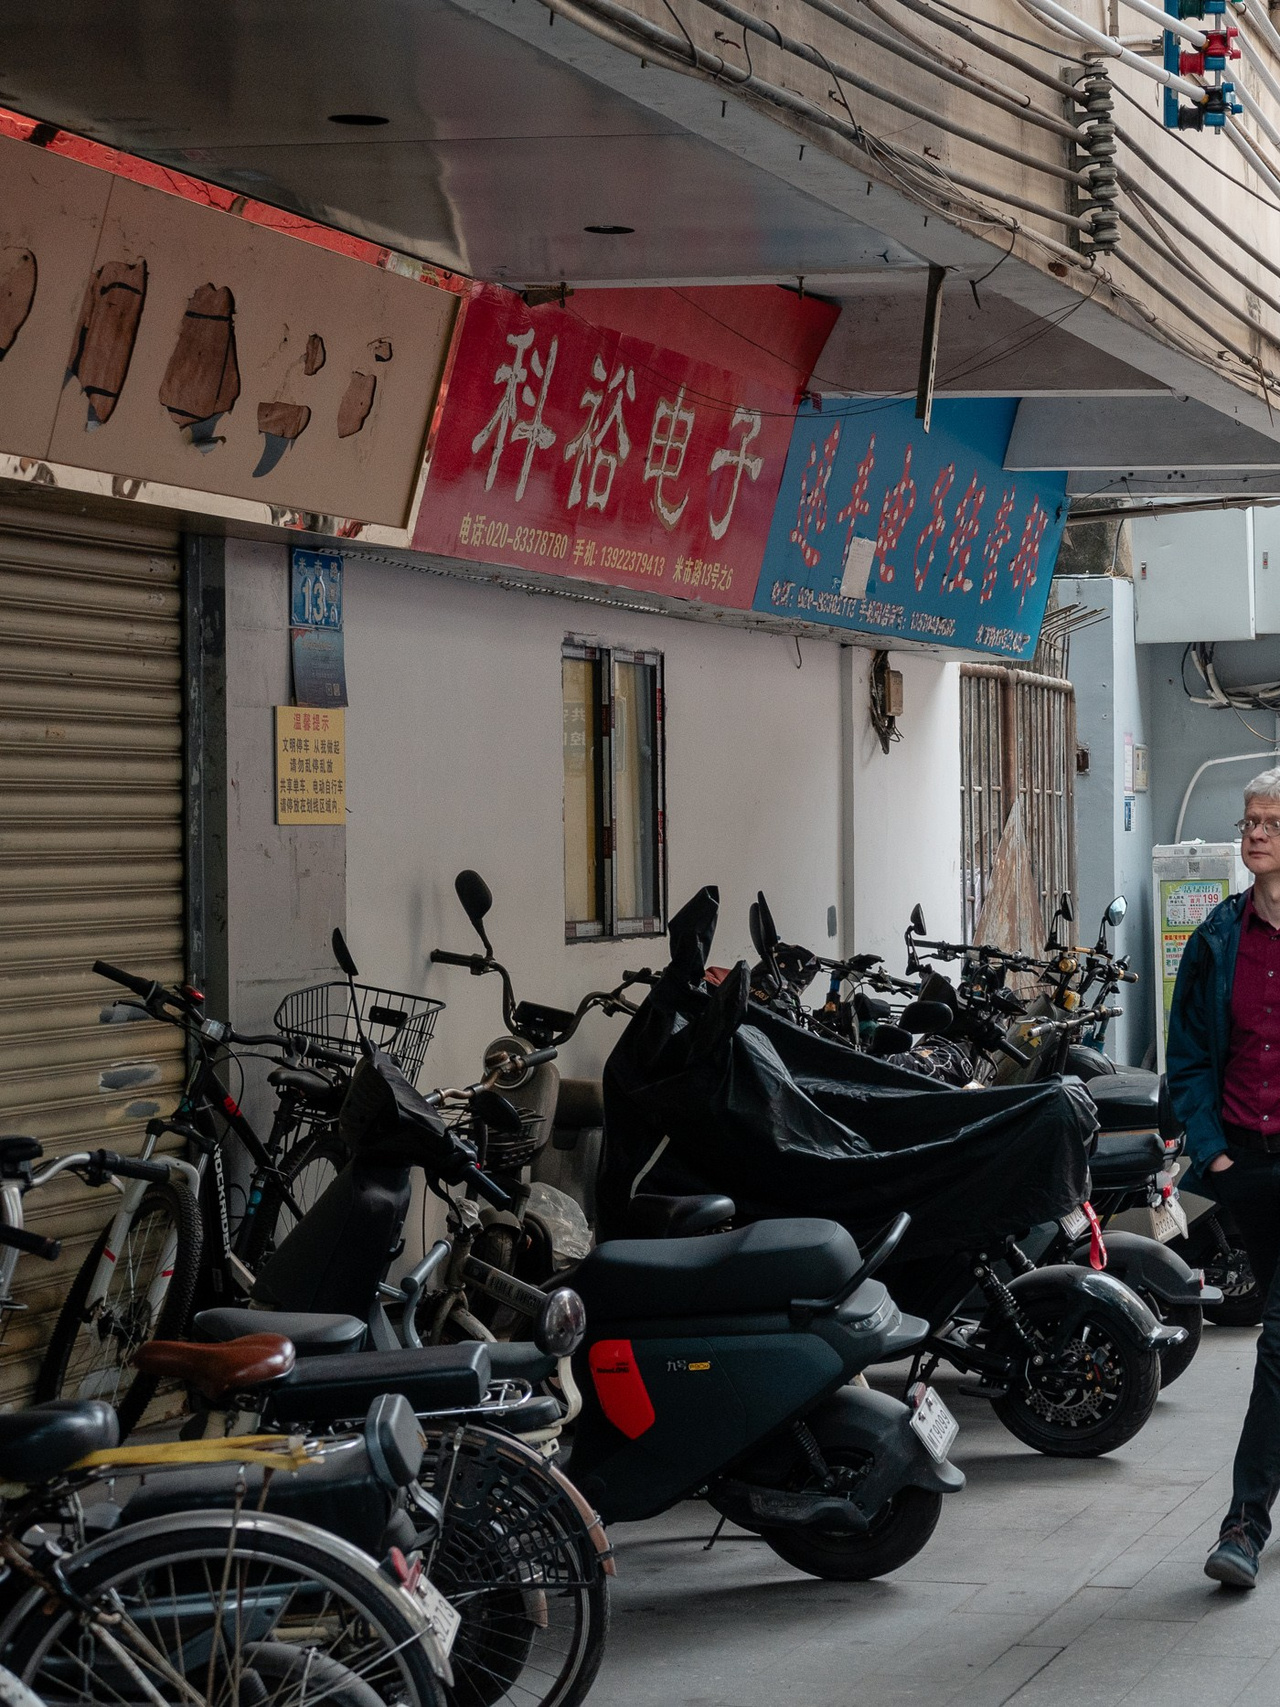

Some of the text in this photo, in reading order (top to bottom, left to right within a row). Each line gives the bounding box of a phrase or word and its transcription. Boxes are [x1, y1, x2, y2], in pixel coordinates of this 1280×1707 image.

[471, 328, 765, 540] 科裕电子
[298, 556, 338, 578] 米市路
[673, 554, 733, 591] 米市路13号之6
[302, 577, 324, 622] 13
[293, 713, 330, 731] 温馨提示
[282, 738, 340, 755] 文明停车 从我做起
[290, 758, 333, 773] 请勿乱停乱放
[280, 778, 343, 794] 共享单车、电动自行车
[1203, 893, 1219, 904] 199
[213, 1143, 232, 1259] ROCKRIDER
[667, 1360, 686, 1372] 九号
